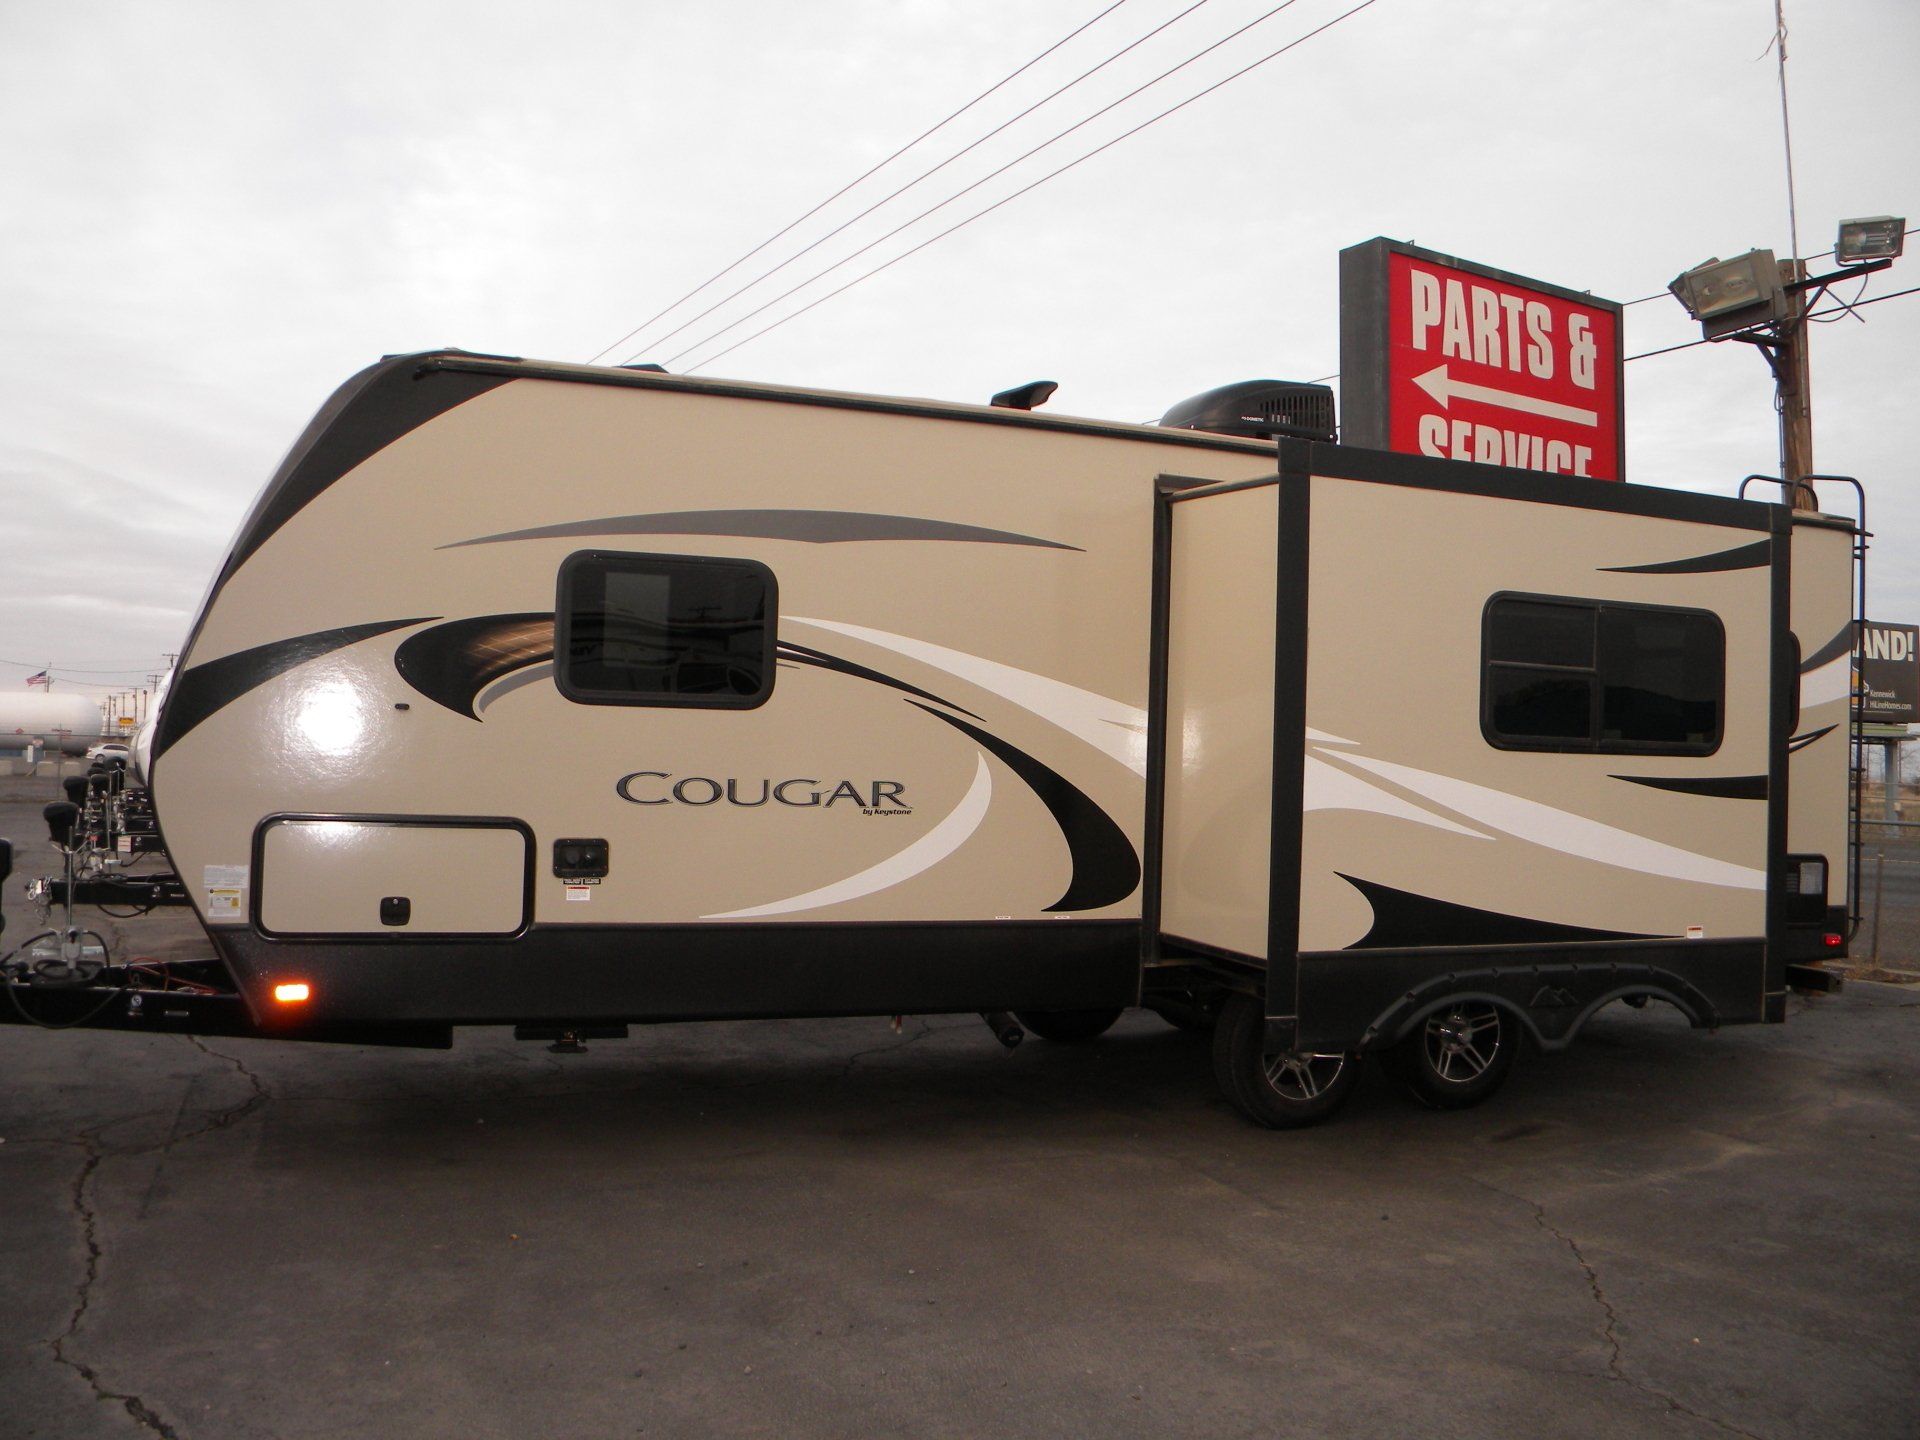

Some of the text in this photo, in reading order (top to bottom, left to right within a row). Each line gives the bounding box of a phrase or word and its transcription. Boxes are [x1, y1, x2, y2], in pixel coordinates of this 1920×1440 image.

[1410, 269, 1597, 390] PARTS &
[1852, 628, 1914, 662] AND!
[616, 771, 913, 809] COUGAR
[862, 808, 912, 816] by Keystone
